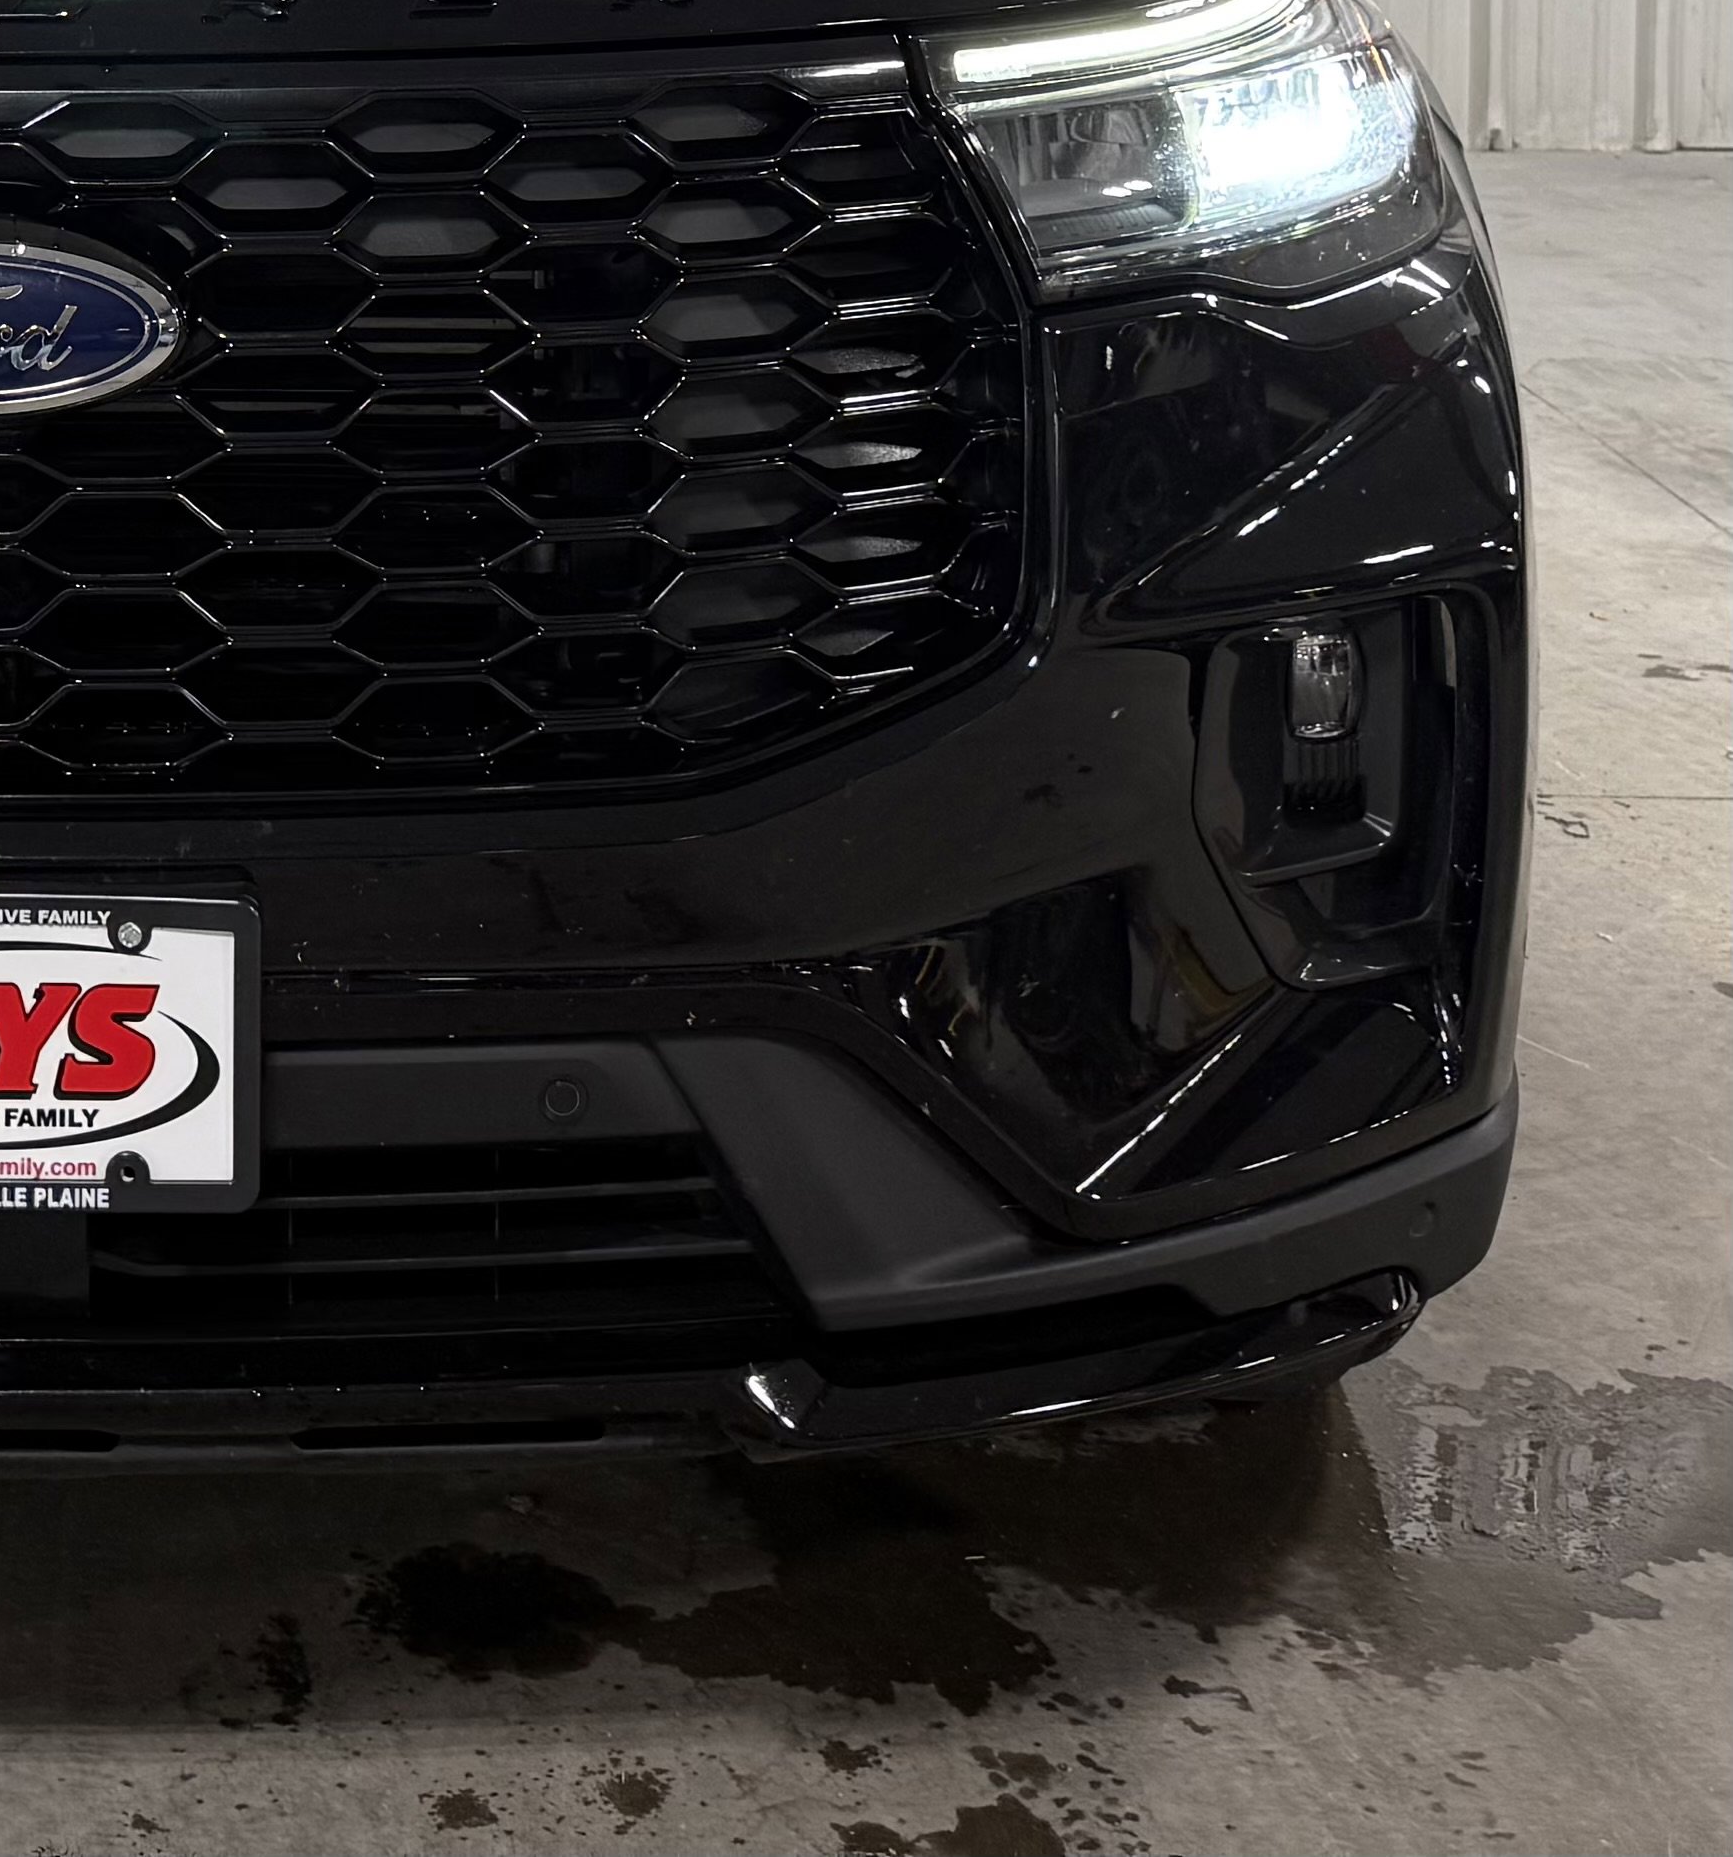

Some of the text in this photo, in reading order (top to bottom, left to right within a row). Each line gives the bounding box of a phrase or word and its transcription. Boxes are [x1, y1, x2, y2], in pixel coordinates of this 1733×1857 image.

[37, 908, 112, 926] FAMILY
[4, 1108, 100, 1128] FAMILY
[33, 1187, 110, 1209] PLAINE
